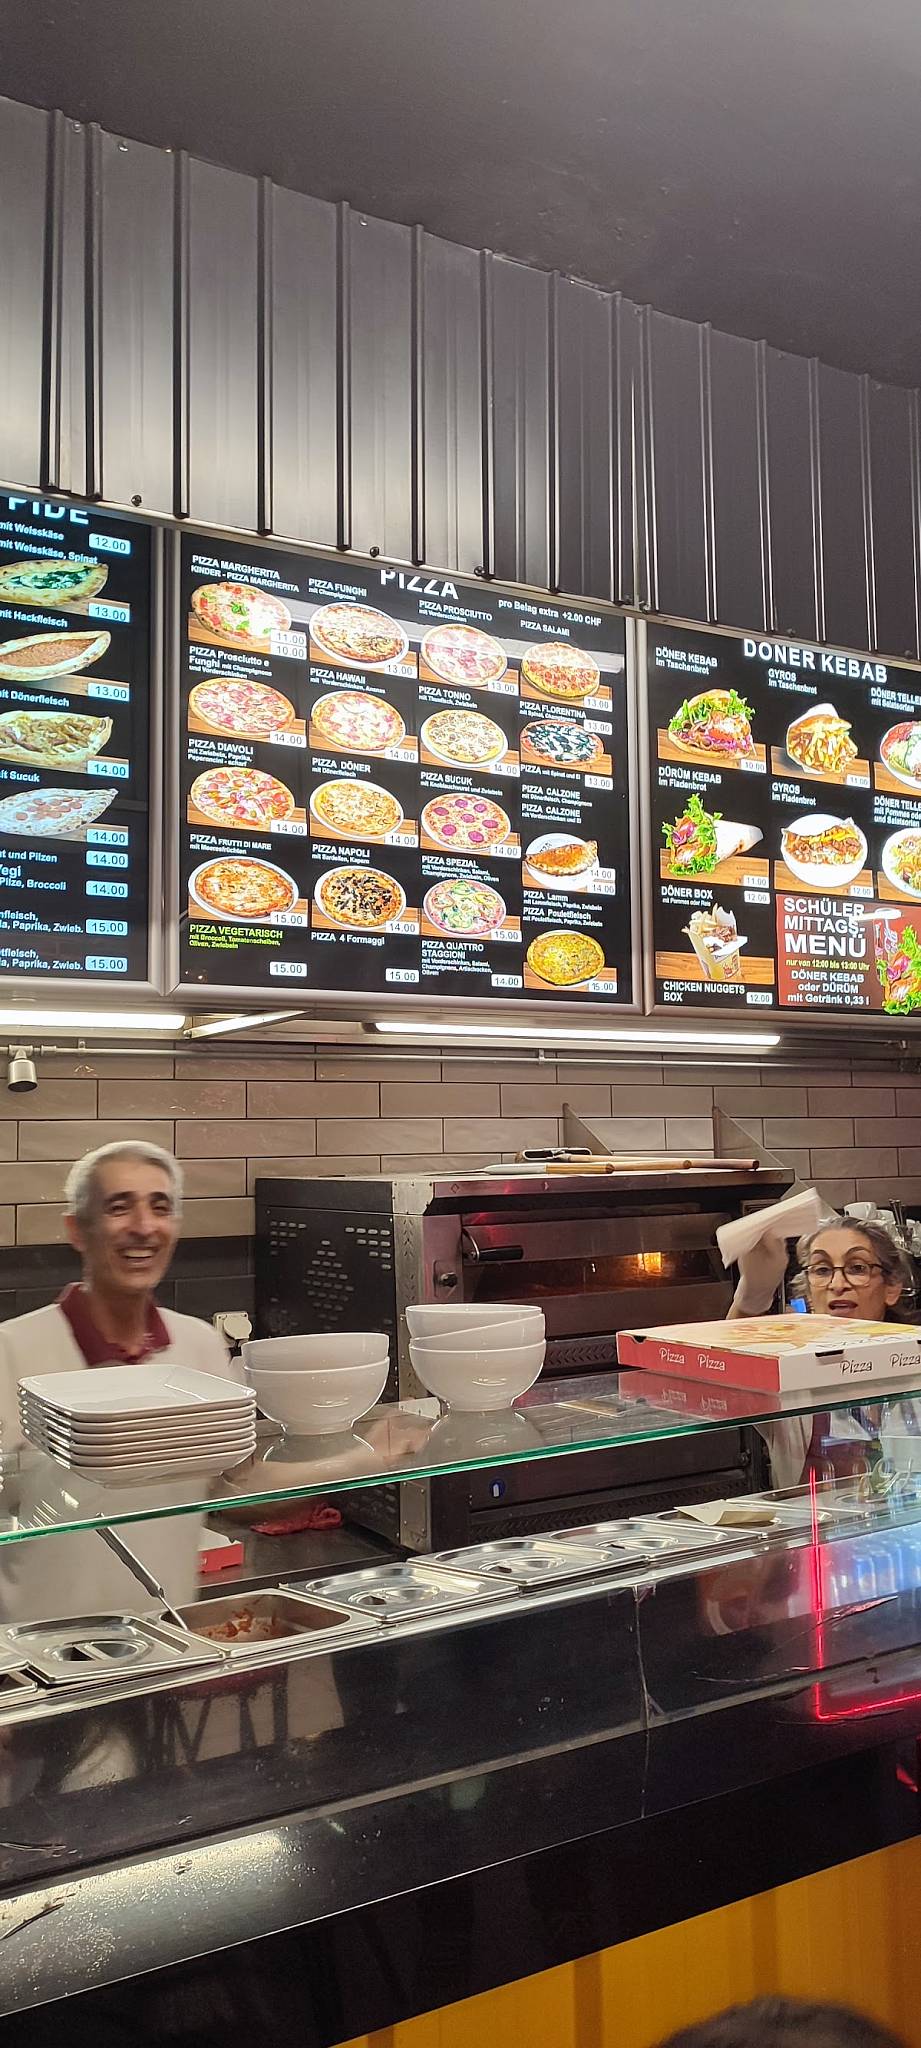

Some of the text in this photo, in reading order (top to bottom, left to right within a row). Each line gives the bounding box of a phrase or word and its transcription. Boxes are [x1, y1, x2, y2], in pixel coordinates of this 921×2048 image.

[15, 523, 64, 540] Weisskäse
[95, 537, 126, 552] 12.00
[14, 542, 98, 565] Weisskäse, Spinat
[192, 555, 280, 579] PIZZA MARGHERITA
[191, 565, 299, 592] KINDER PIZZA MARGHERITA
[380, 569, 459, 599] PIZZA
[309, 578, 367, 596] PIZZA FUNGHI
[95, 606, 126, 621] 13.00
[419, 600, 492, 621] PIZZA PROSCIUTTO
[498, 600, 601, 627] pro Belag extra +2.00 CHF
[14, 612, 67, 627] Hackfleisch
[520, 620, 570, 636] PIZZA SALAMI
[277, 632, 304, 645] 11.00
[189, 646, 216, 658] PIZZA
[218, 651, 262, 665] Prosciutto
[277, 646, 304, 657] 10.00
[656, 647, 718, 667] DÖNER KEBAB
[189, 656, 220, 668] Funghi
[667, 659, 709, 675] Taschenbrot
[388, 664, 412, 675] 13.00
[768, 669, 797, 682] GYROS
[822, 655, 888, 683] KEBAB
[310, 668, 365, 684] PIZZA HAWAII
[95, 686, 127, 699] 13.00
[419, 686, 471, 700] PIZZA TONNO
[491, 682, 515, 693] 13.00
[778, 680, 817, 695] Taschenbrot
[871, 686, 896, 700] DÖNER
[11, 691, 69, 707] Dönerfleisch
[587, 699, 609, 709] 13.00
[520, 701, 586, 718] PIZZA FLORENTINA
[275, 733, 303, 745] 14.00
[189, 739, 253, 755] PIZZA DIAVOLI
[390, 750, 415, 760] 14.00
[94, 764, 126, 776] 14.00
[312, 758, 371, 773] PIZZA DÖNER
[494, 764, 517, 774] 14.00
[521, 764, 541, 774] PIZZA
[10, 771, 40, 782] Sucuk
[421, 772, 473, 785] PIZZA SUCUK
[658, 766, 721, 784] DÜRÜM KEBAB
[522, 785, 580, 799] PIZZA CALZONE
[669, 779, 707, 792] Fladenbrot
[772, 782, 800, 795] GYROS
[782, 793, 816, 806] Fladenbrot
[874, 795, 899, 808] DÖNER
[522, 803, 580, 817] PIZZA CALZONE
[277, 823, 304, 834] 14.00
[93, 832, 125, 843] 14.00
[190, 834, 272, 850] PIZZA FRUTTI DI MARE
[390, 835, 416, 845] 14.00
[8, 852, 57, 862] und Pilzen
[313, 844, 370, 857] PIZZA NAPOLI
[494, 846, 518, 856] 14.00
[93, 854, 125, 865] 14.00
[422, 856, 478, 868] PIZZA SPEZIAL
[27, 880, 66, 890] Broccoli
[746, 877, 766, 886] 11.00
[92, 884, 125, 895] 14.00
[592, 884, 614, 894] 14.00
[661, 885, 713, 899] DÖNER BOX
[853, 886, 871, 895] 12.00
[524, 890, 568, 902] PIZZA Lamm
[746, 893, 767, 902] 12.00
[523, 907, 591, 919] PIZZA Pouletfleisch
[784, 897, 864, 918] SCHÜLER
[275, 914, 303, 924] 15.00
[784, 915, 865, 935] MITTAGS-
[13, 921, 84, 933] Paprika, Zwieb.
[92, 922, 124, 933] 15.00
[189, 924, 283, 939] PIZZA VEGETARISCH
[390, 923, 416, 932] 14.00
[311, 932, 385, 945] PIZZA 4 Formaggi
[495, 930, 518, 940] 15.00
[422, 940, 484, 951] PIZZA QUATTRO
[784, 932, 866, 958] MENÜ
[422, 950, 465, 959] STAGGIONI
[12, 959, 84, 971] Paprika, Zwieb.
[91, 960, 123, 969] 15.00
[274, 964, 302, 973] 15.00
[786, 959, 870, 971] nur von 12:00 bis 13:00 Uhr
[390, 971, 416, 981] 15.00
[495, 976, 519, 986] 14.00
[791, 969, 864, 983] DÖNER KEBAB
[591, 982, 613, 991] 15.00
[663, 981, 745, 995] CHICKEN NUGGETS
[798, 982, 859, 994] oder DÜRÜM
[663, 992, 683, 1002] BOX
[750, 994, 770, 1003] 12.00
[787, 993, 863, 1006] mit Getränk 0,33
[659, 1348, 685, 1364] Pizza
[890, 1354, 921, 1368] Pizza
[697, 1354, 725, 1372] Pizza
[840, 1361, 872, 1375] Pizza
